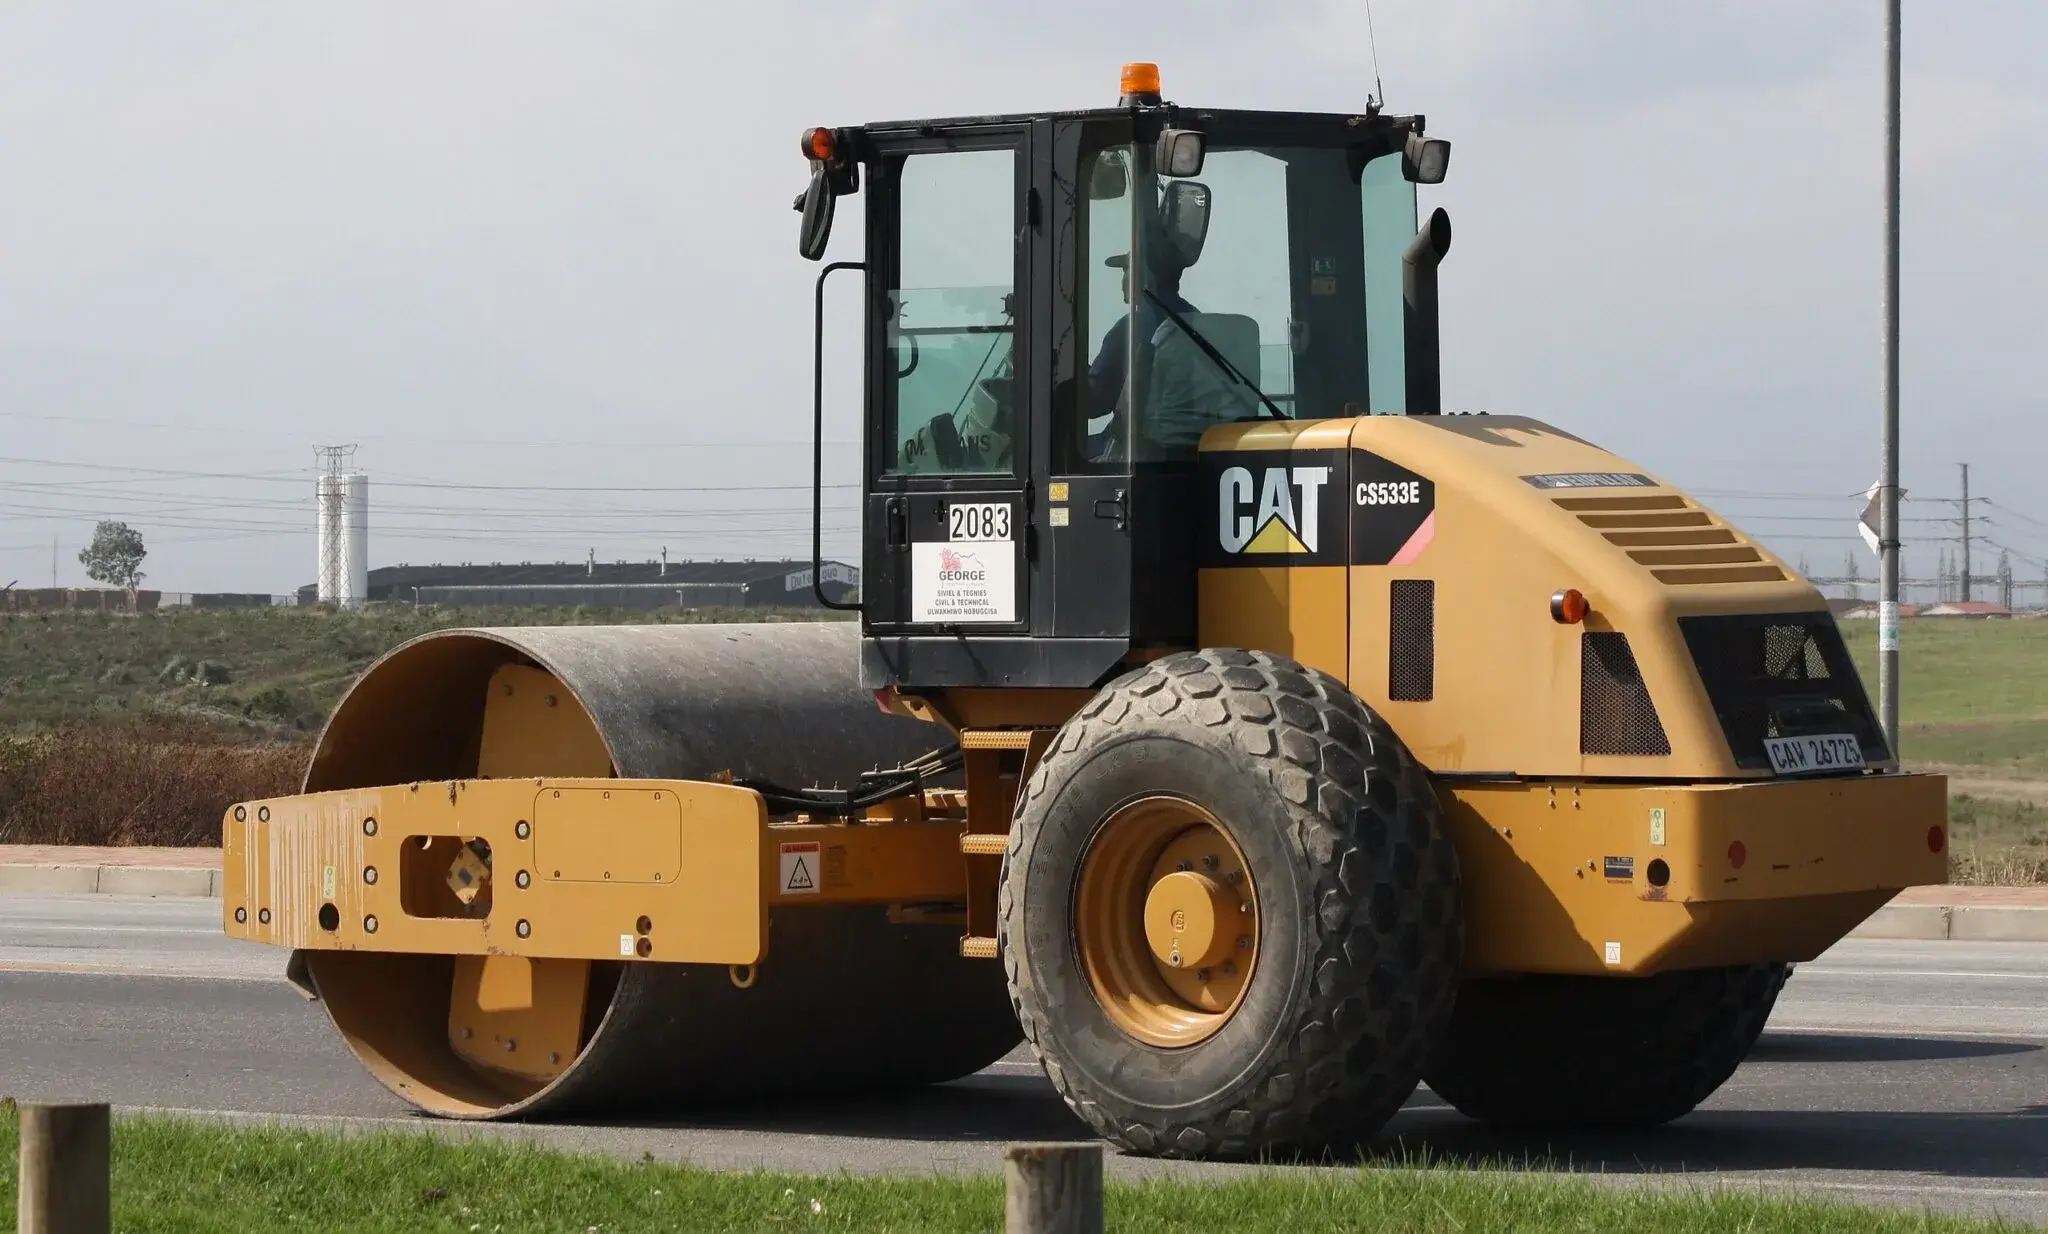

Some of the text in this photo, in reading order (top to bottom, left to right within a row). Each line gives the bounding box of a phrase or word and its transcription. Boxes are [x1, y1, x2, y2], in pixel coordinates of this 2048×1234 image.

[1356, 481, 1420, 506] CS533E
[951, 506, 1009, 538] 2083
[1219, 466, 1328, 553] CAT
[939, 570, 985, 581] GEORGE
[1809, 739, 1861, 766] 26725
